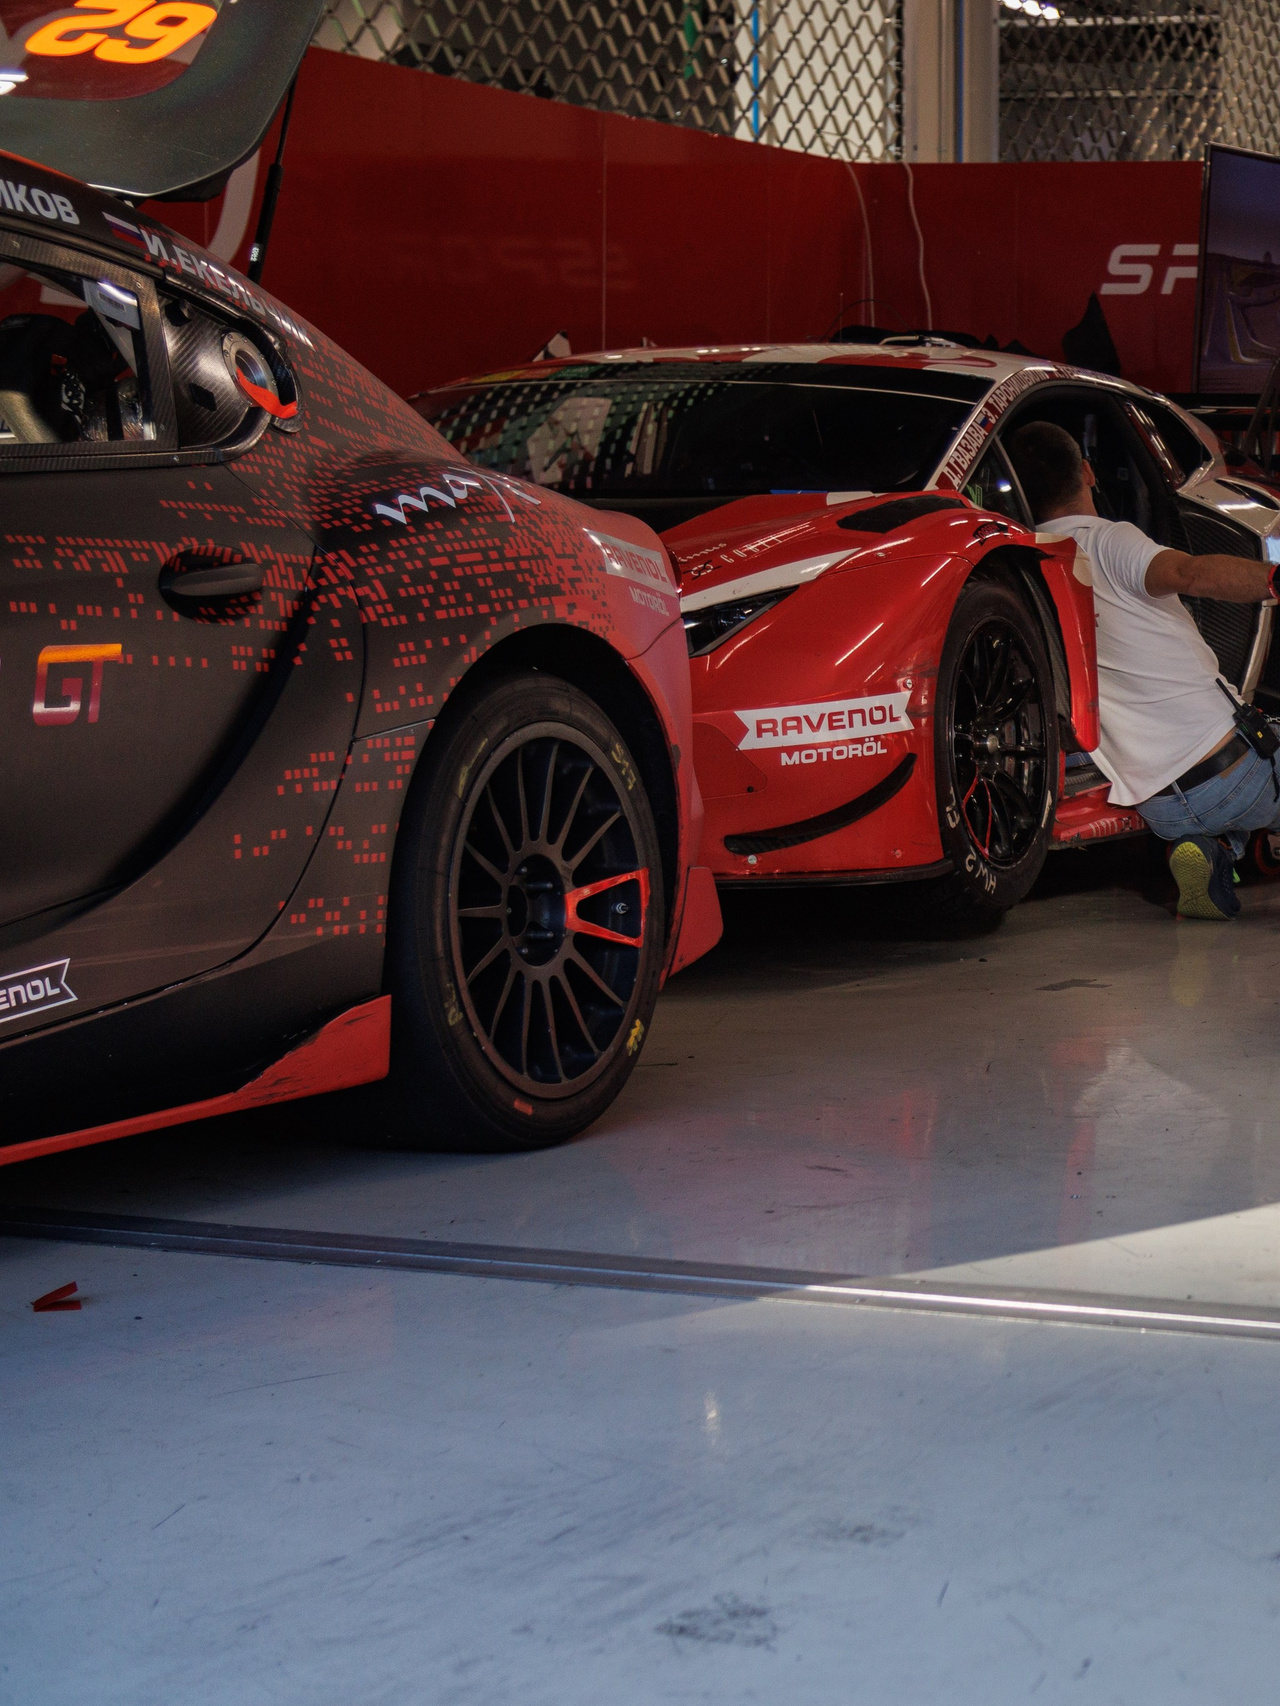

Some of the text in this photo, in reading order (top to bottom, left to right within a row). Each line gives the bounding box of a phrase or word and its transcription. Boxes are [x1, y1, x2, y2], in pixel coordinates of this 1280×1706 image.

[25, 0, 218, 64] 29
[601, 541, 669, 583] RAVENOL
[32, 643, 122, 725] GT
[755, 703, 902, 739] RAVENOL
[781, 736, 888, 766] MOTORÖL
